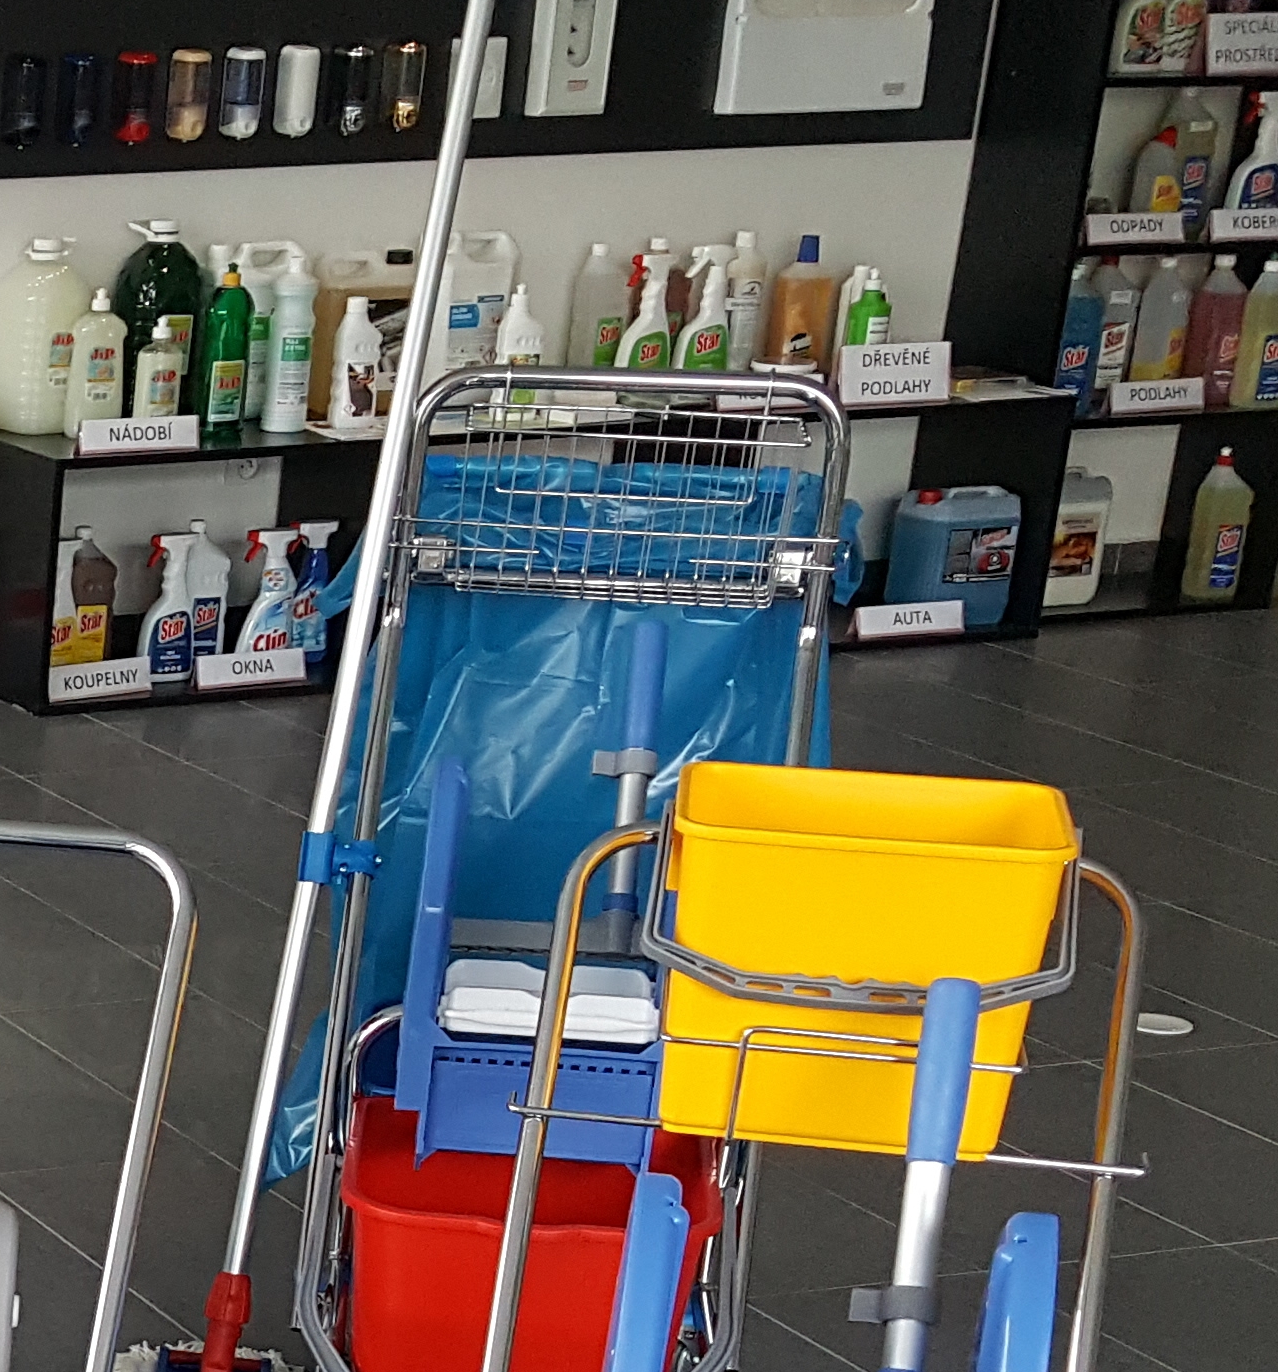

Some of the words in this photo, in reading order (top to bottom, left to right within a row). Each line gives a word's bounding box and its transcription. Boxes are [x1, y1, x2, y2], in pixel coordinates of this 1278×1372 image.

[1110, 218, 1163, 234] ODPADY
[697, 332, 721, 354] Star
[862, 347, 931, 368] DŘEVĚNÉ
[861, 380, 931, 396] PODLAHY
[1130, 386, 1189, 402] PODLAHY
[109, 422, 172, 442] NÁDOBÍ
[80, 614, 104, 633] Star
[196, 608, 217, 625] Star
[893, 611, 933, 626] AUTA
[160, 619, 185, 641] Star
[253, 629, 287, 652] Clin
[232, 659, 275, 675] OKNA
[64, 669, 138, 691] KOUPELNY
